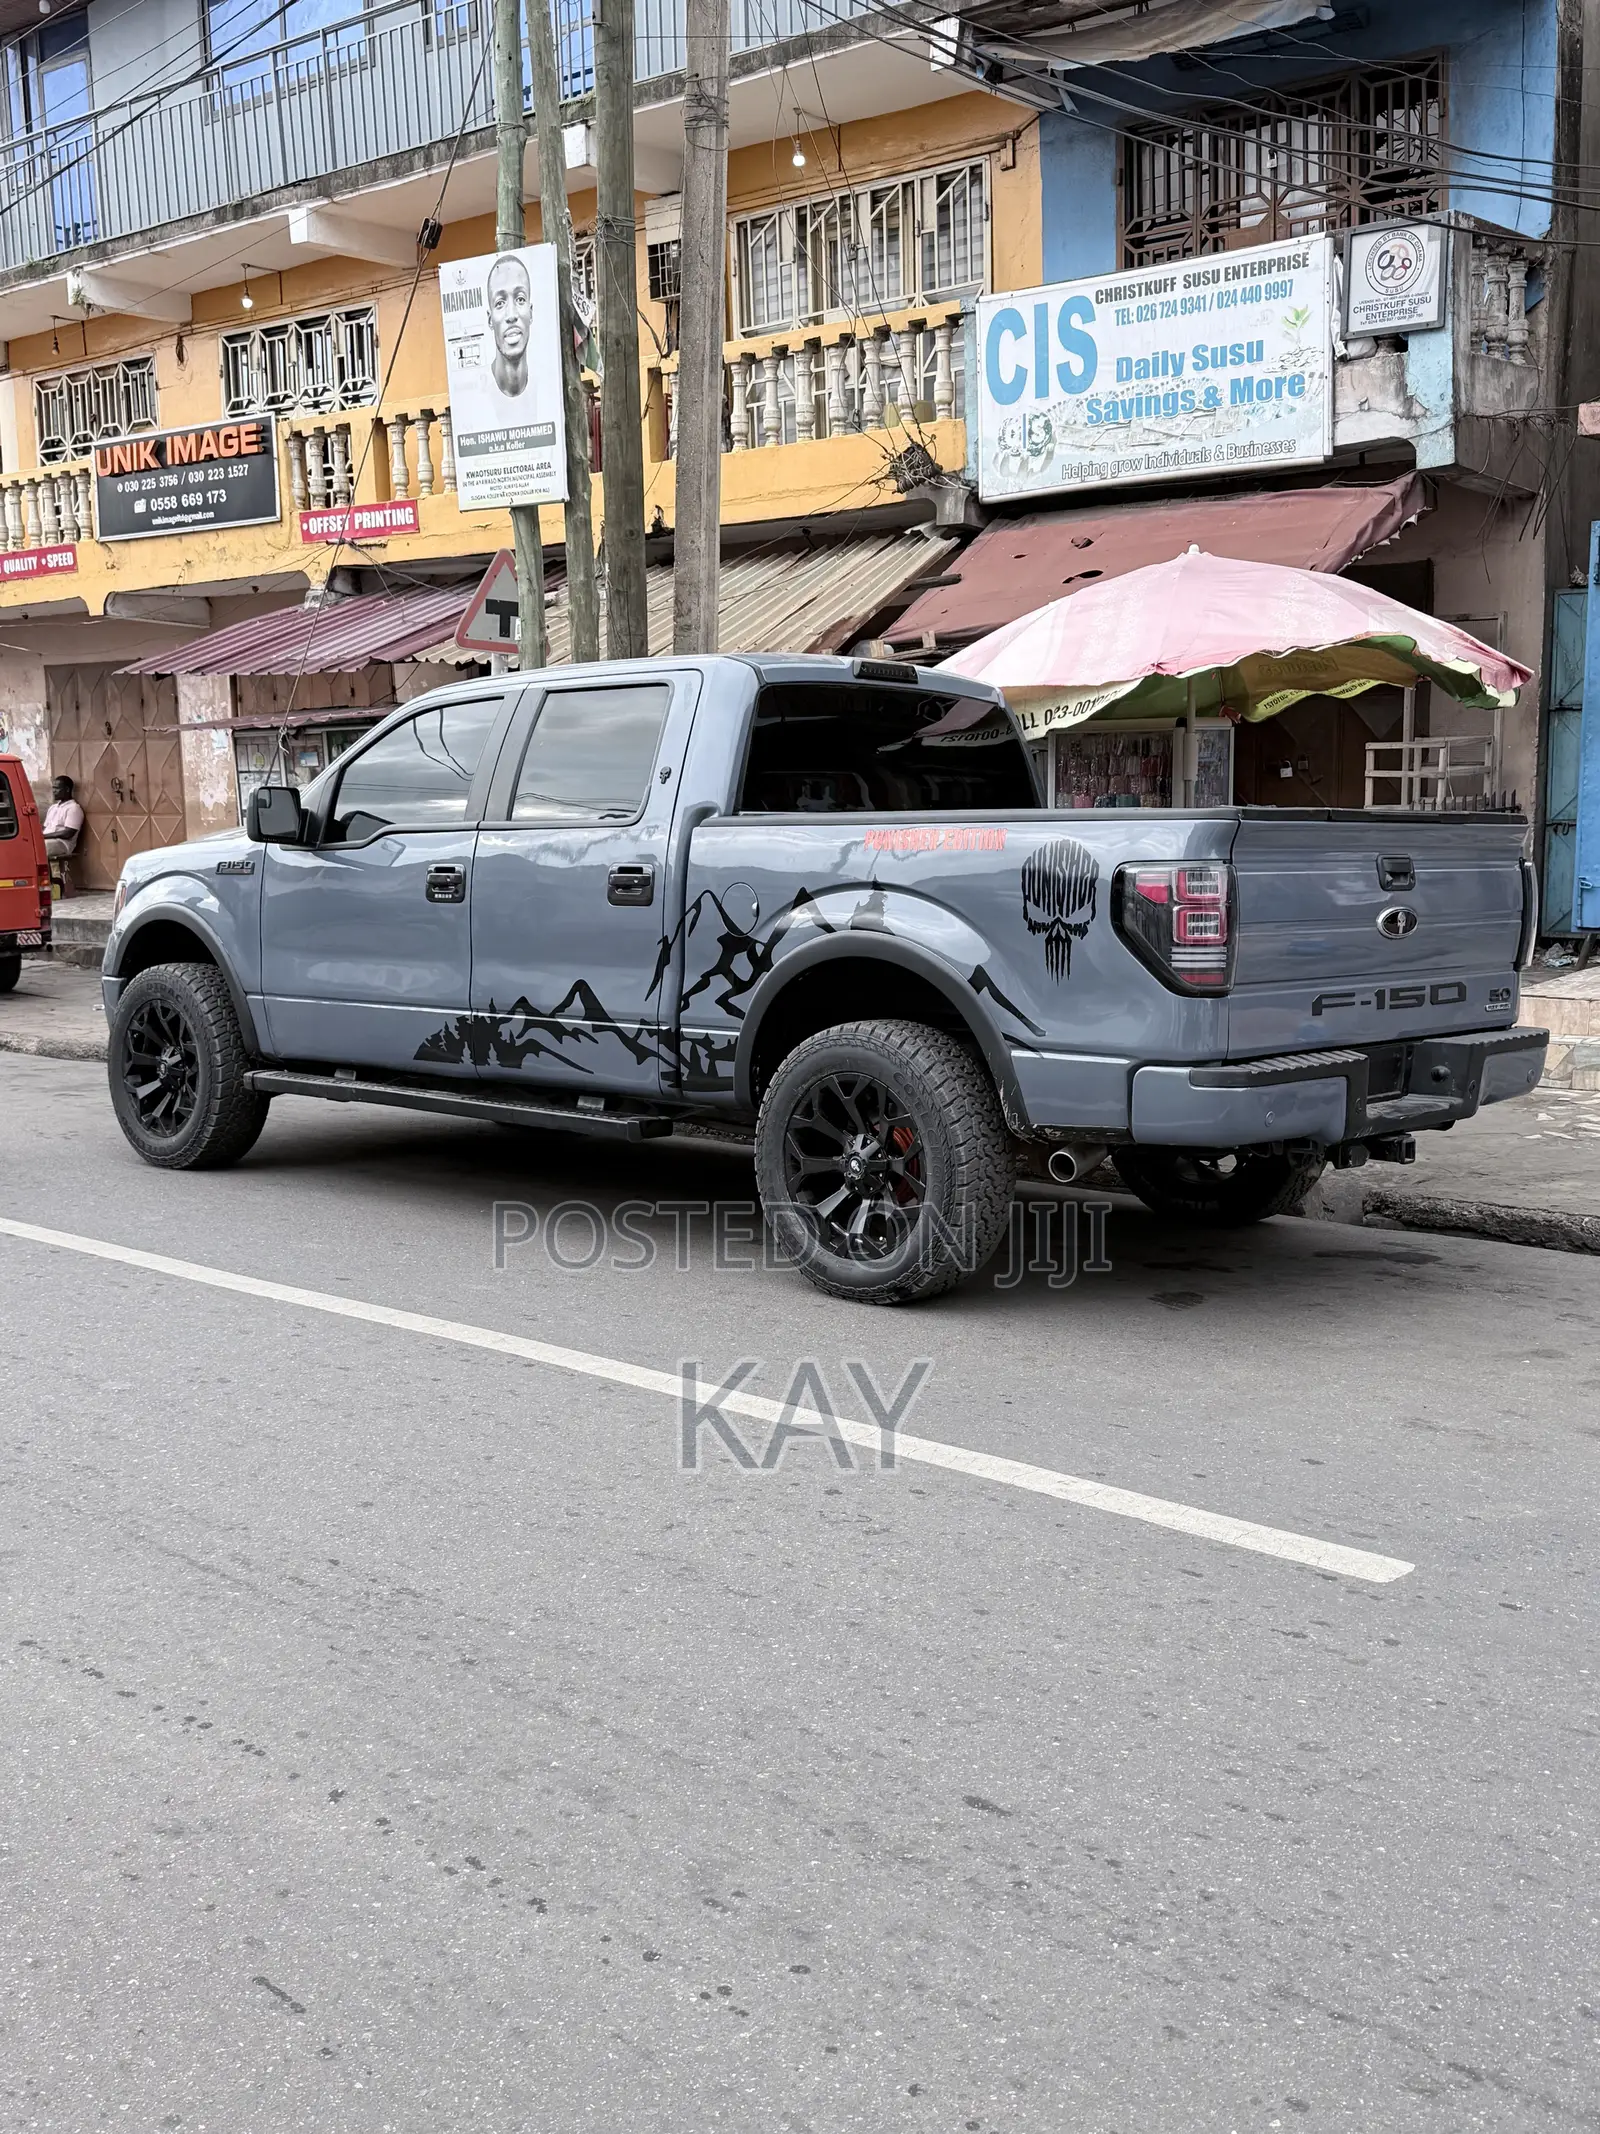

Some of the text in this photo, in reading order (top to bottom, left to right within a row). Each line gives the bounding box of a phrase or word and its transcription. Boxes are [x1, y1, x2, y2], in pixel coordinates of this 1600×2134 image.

[1095, 252, 1310, 304] CHRISTKUFF SUSU ENTERPRISE
[443, 287, 482, 314] MAINTAIN
[1115, 308, 1134, 326] TEL:
[1136, 302, 1157, 322] 026
[1160, 300, 1178, 318] 724
[1180, 294, 1206, 316] 9341
[1216, 290, 1238, 309] 024
[1240, 285, 1262, 305] 440
[1265, 279, 1294, 300] 9997
[1353, 300, 1406, 314] CHRISTKUFF
[1408, 296, 1432, 306] SUSU
[1366, 306, 1418, 320] ENTERPRISE
[986, 295, 1098, 406] CIS
[1116, 340, 1264, 383] Daily Susu
[1086, 372, 1306, 425] Savings & More
[460, 424, 552, 446] Hon. ISHAWU MOHAMMED
[96, 422, 264, 477] UNIK IMAGE
[1062, 439, 1296, 482] Helping grow Individuals & Businesses
[124, 482, 139, 492] 030
[142, 479, 156, 489] 225
[159, 474, 178, 488] 3756
[188, 470, 204, 484] 030
[207, 468, 224, 480] 223
[228, 464, 249, 478] 1527
[504, 464, 534, 476] ELECTORAL
[536, 462, 552, 470] AREA
[151, 489, 226, 511] 0558 669 173
[308, 507, 414, 534] OFFSET PRINTING
[4, 552, 74, 574] QUALITY SPEED
[943, 828, 1008, 850] EDITION
[1312, 982, 1466, 1016] F-150
